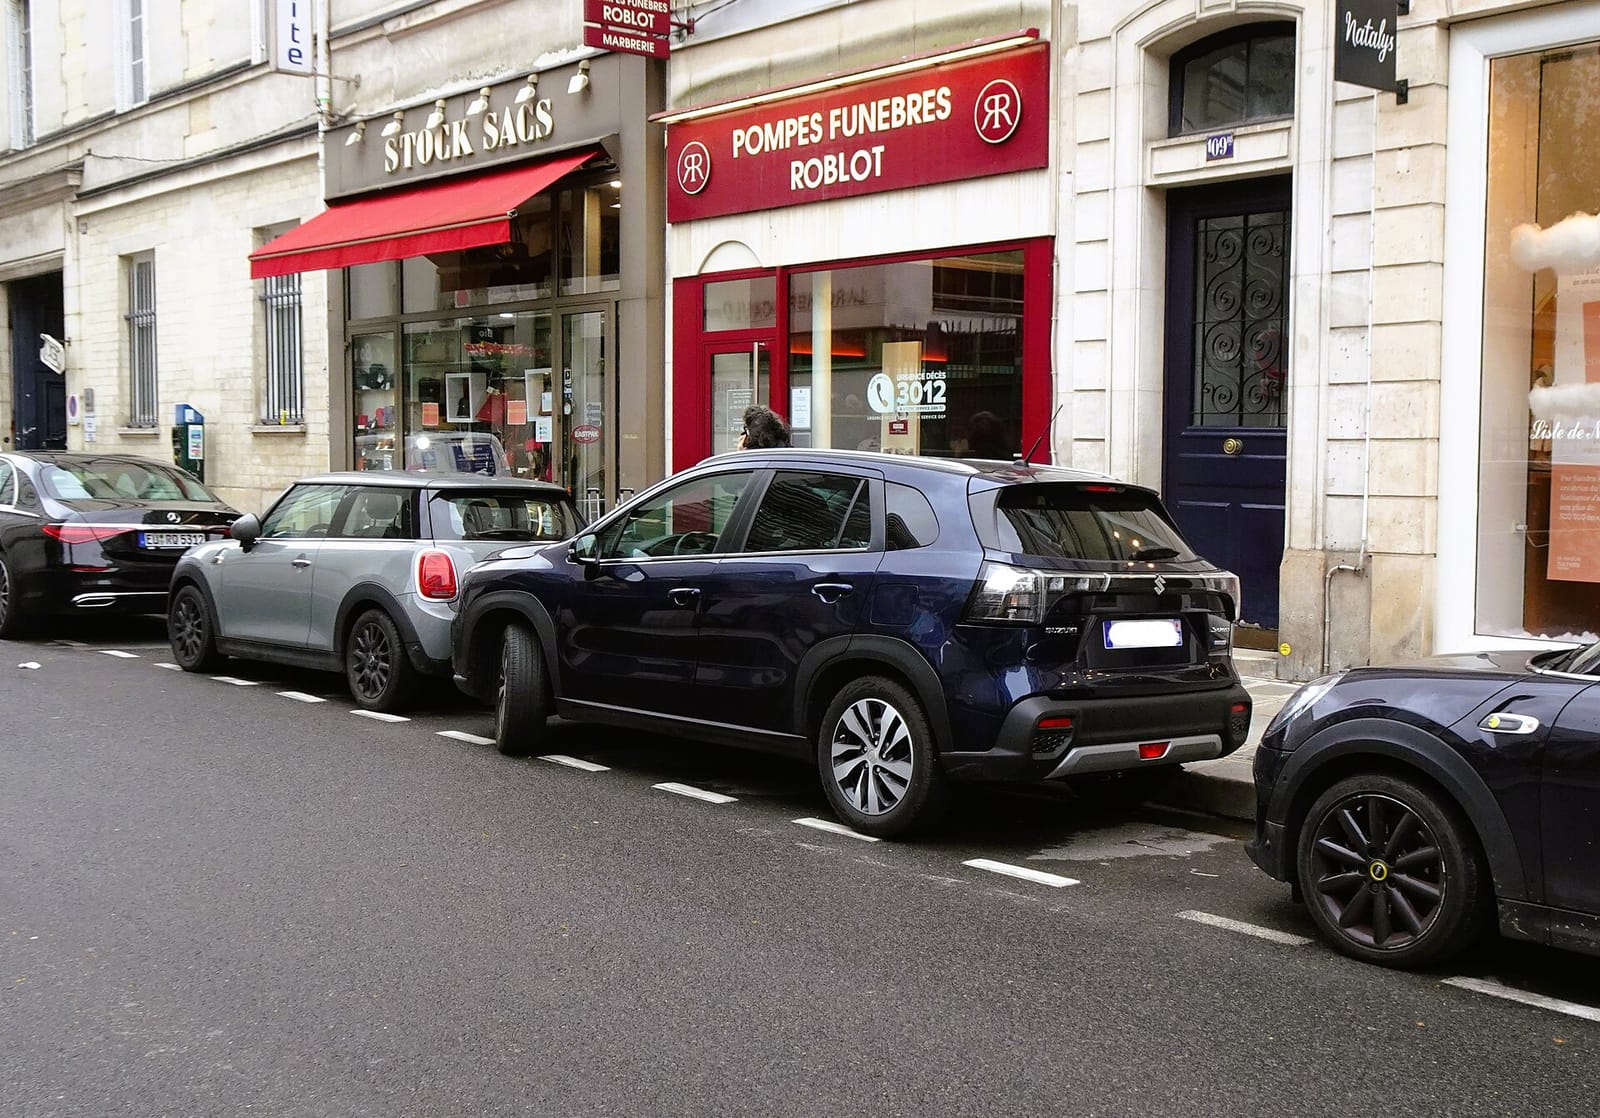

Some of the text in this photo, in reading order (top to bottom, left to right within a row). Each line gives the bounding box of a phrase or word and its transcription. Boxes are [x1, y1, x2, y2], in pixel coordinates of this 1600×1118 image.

[603, 5, 655, 28] ROBLOT
[603, 33, 655, 53] MARBRERIE
[1345, 11, 1394, 63] Natalys
[732, 86, 952, 158] POMPES FUNEBRES
[384, 98, 553, 173] STOCK SACS
[1207, 136, 1228, 156] 109
[790, 146, 885, 191] ROBLOT
[897, 370, 946, 381] URGENCE DÉCÈS
[896, 380, 946, 404] 3012
[1530, 419, 1565, 439] Liste
[1567, 421, 1585, 439] de
